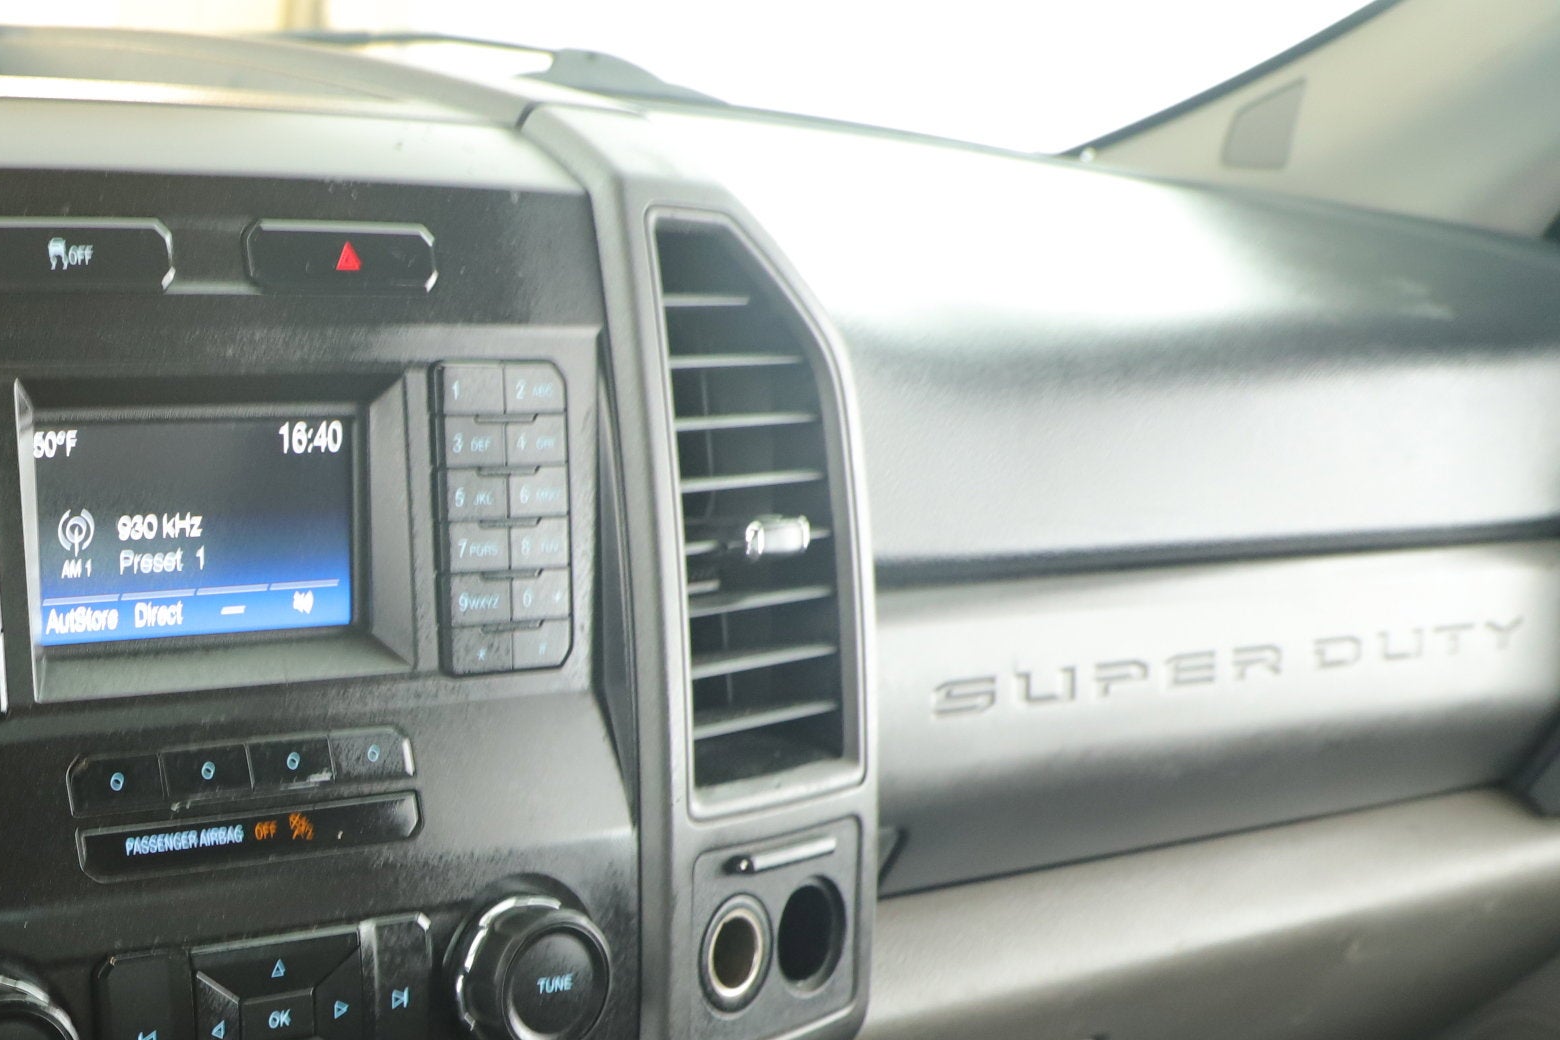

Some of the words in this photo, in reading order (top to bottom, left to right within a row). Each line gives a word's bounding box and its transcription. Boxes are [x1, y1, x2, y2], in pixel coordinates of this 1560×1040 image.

[68, 245, 94, 266] OFF
[452, 380, 460, 401] 1
[515, 379, 527, 400] 2
[278, 419, 343, 454] 16:40
[452, 432, 463, 453] 3
[458, 538, 468, 559] 7
[61, 559, 82, 579] AM
[84, 558, 92, 578] 1
[119, 547, 184, 576] Preset
[196, 545, 205, 572] 1
[45, 606, 119, 635] AutStore
[134, 600, 184, 629] Direct
[932, 644, 1283, 720] SUPER
[1313, 615, 1525, 670] DUTY
[125, 829, 199, 857] PASSENGER
[199, 824, 245, 848] AIRBAG
[254, 820, 278, 840] OFF
[536, 973, 575, 994] TUNE
[267, 1008, 291, 1029] OK
